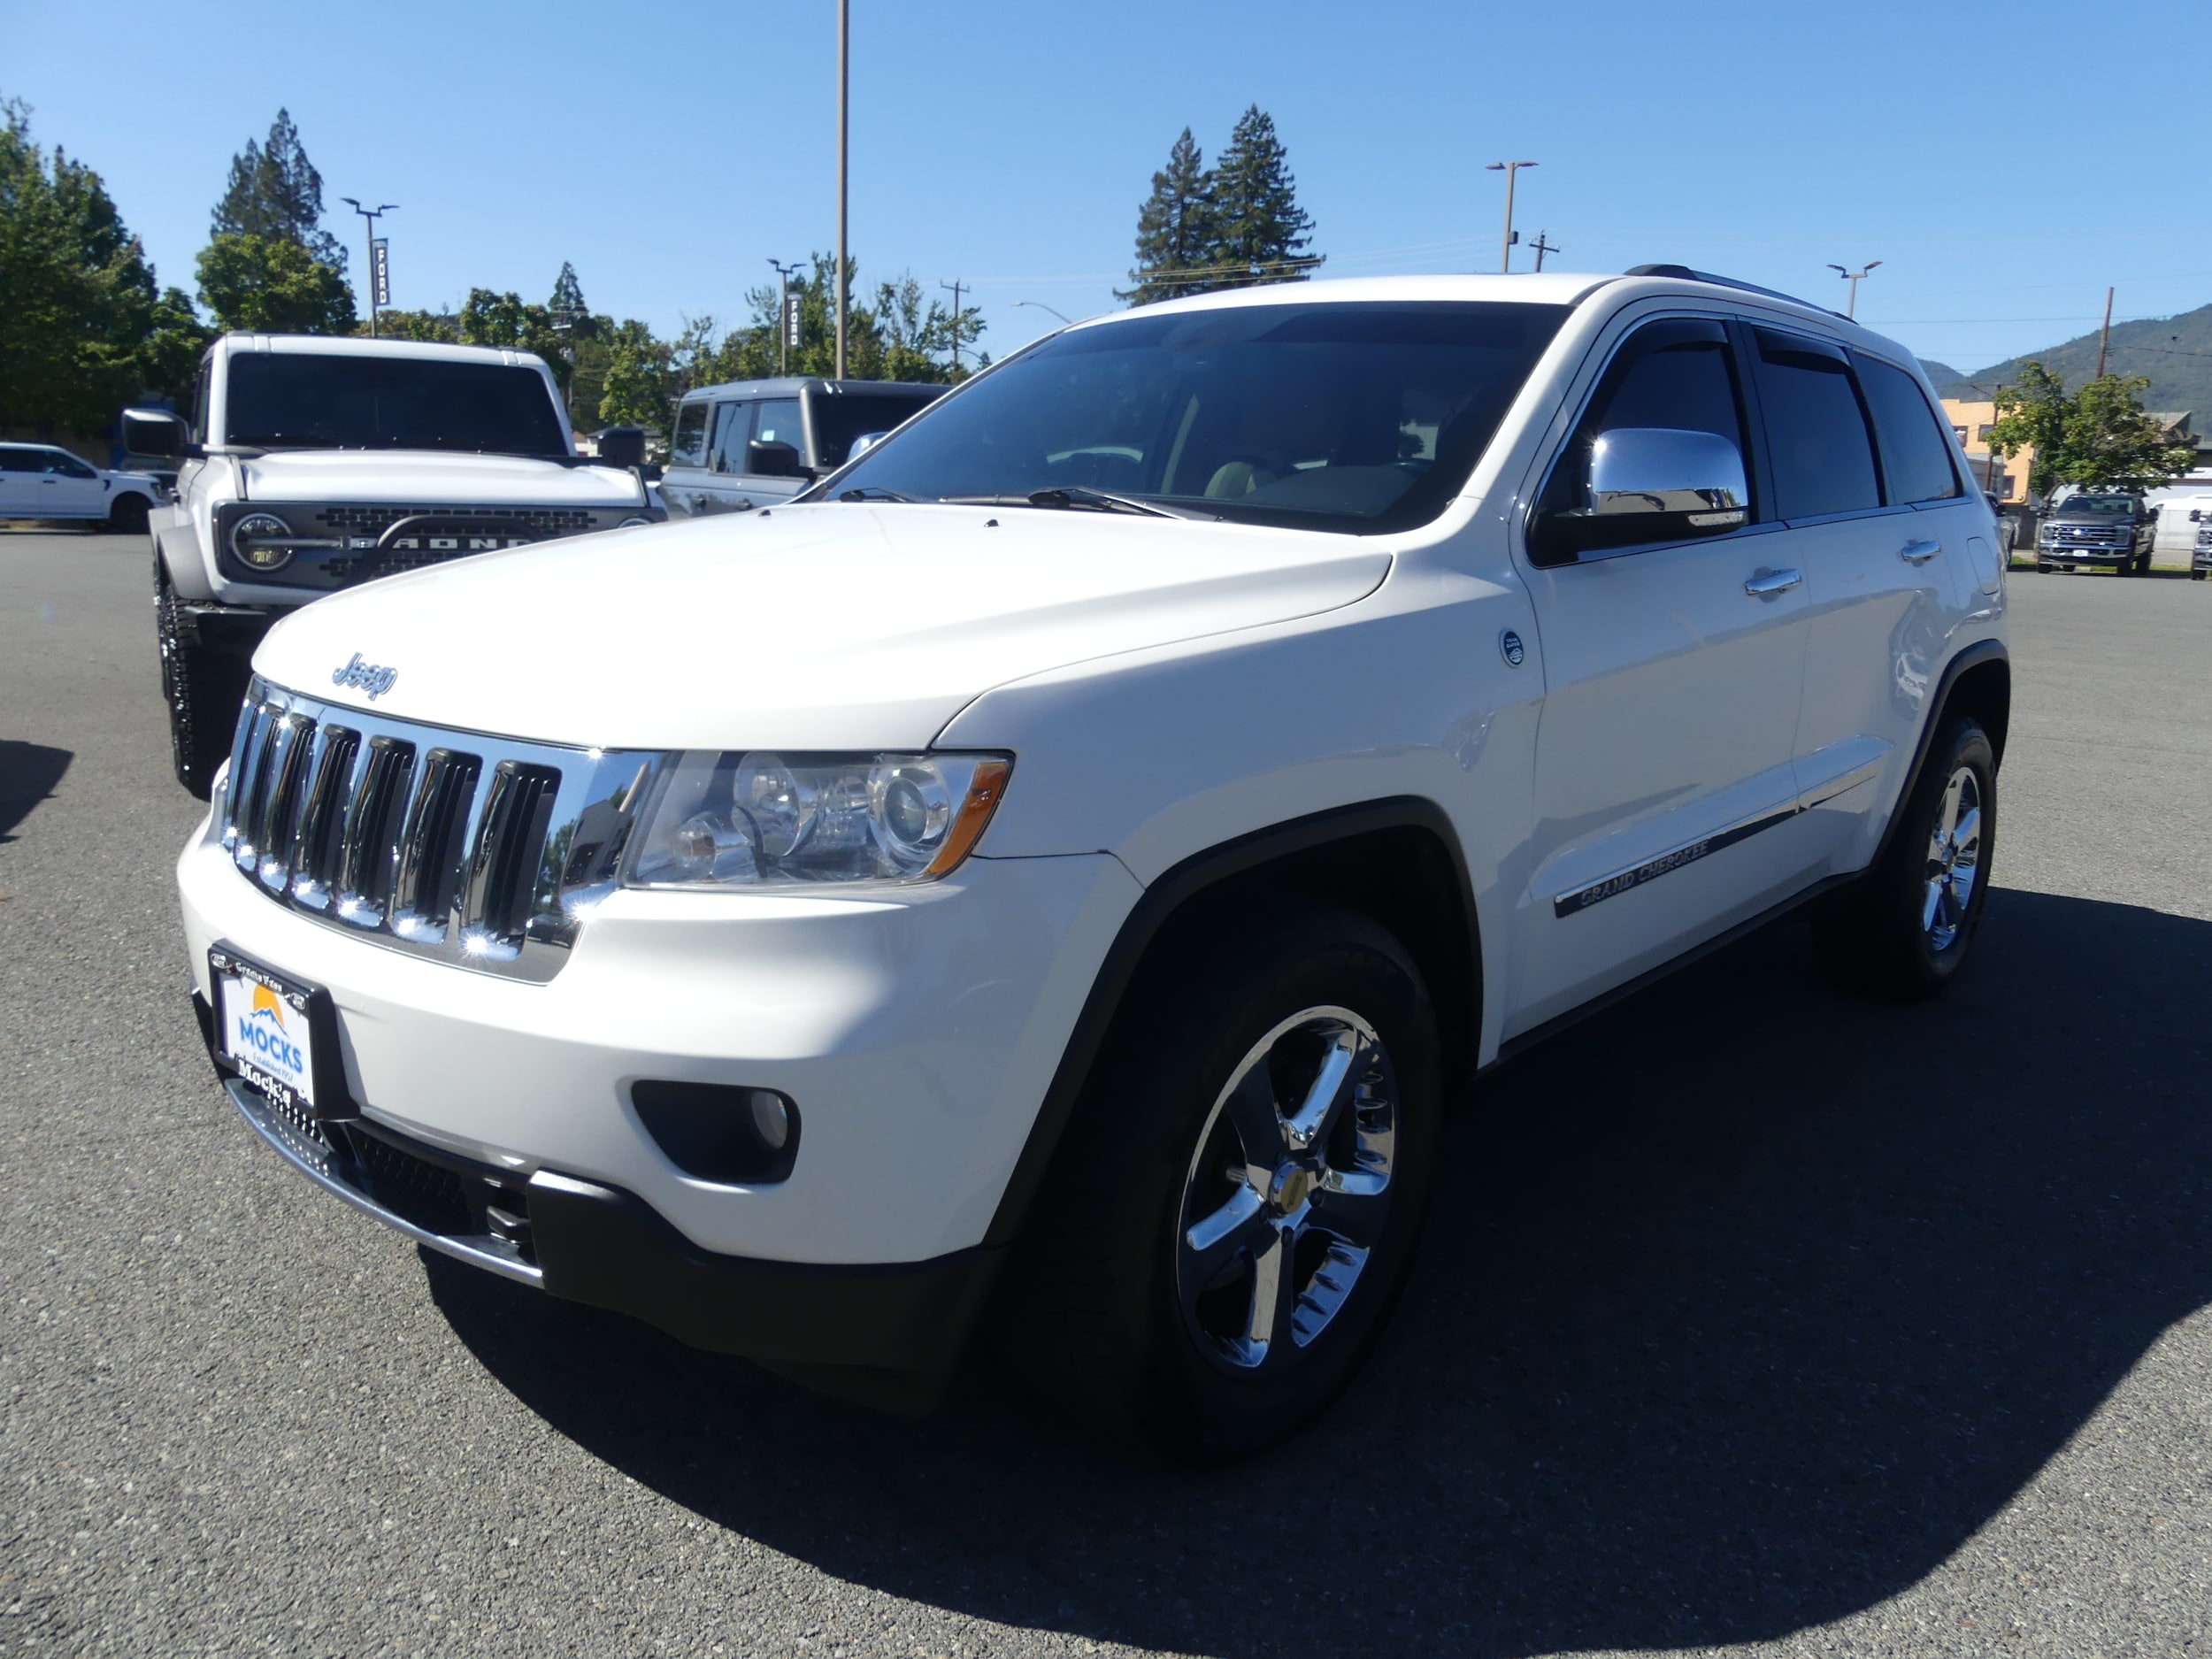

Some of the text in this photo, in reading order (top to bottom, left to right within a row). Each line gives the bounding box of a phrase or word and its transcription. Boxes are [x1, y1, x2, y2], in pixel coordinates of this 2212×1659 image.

[378, 249, 387, 303] FORD
[349, 537, 534, 549] BRONC
[332, 651, 398, 701] Jeep
[1581, 840, 1709, 906] GRAND CHEROKEE
[239, 1016, 303, 1073] MOCKS
